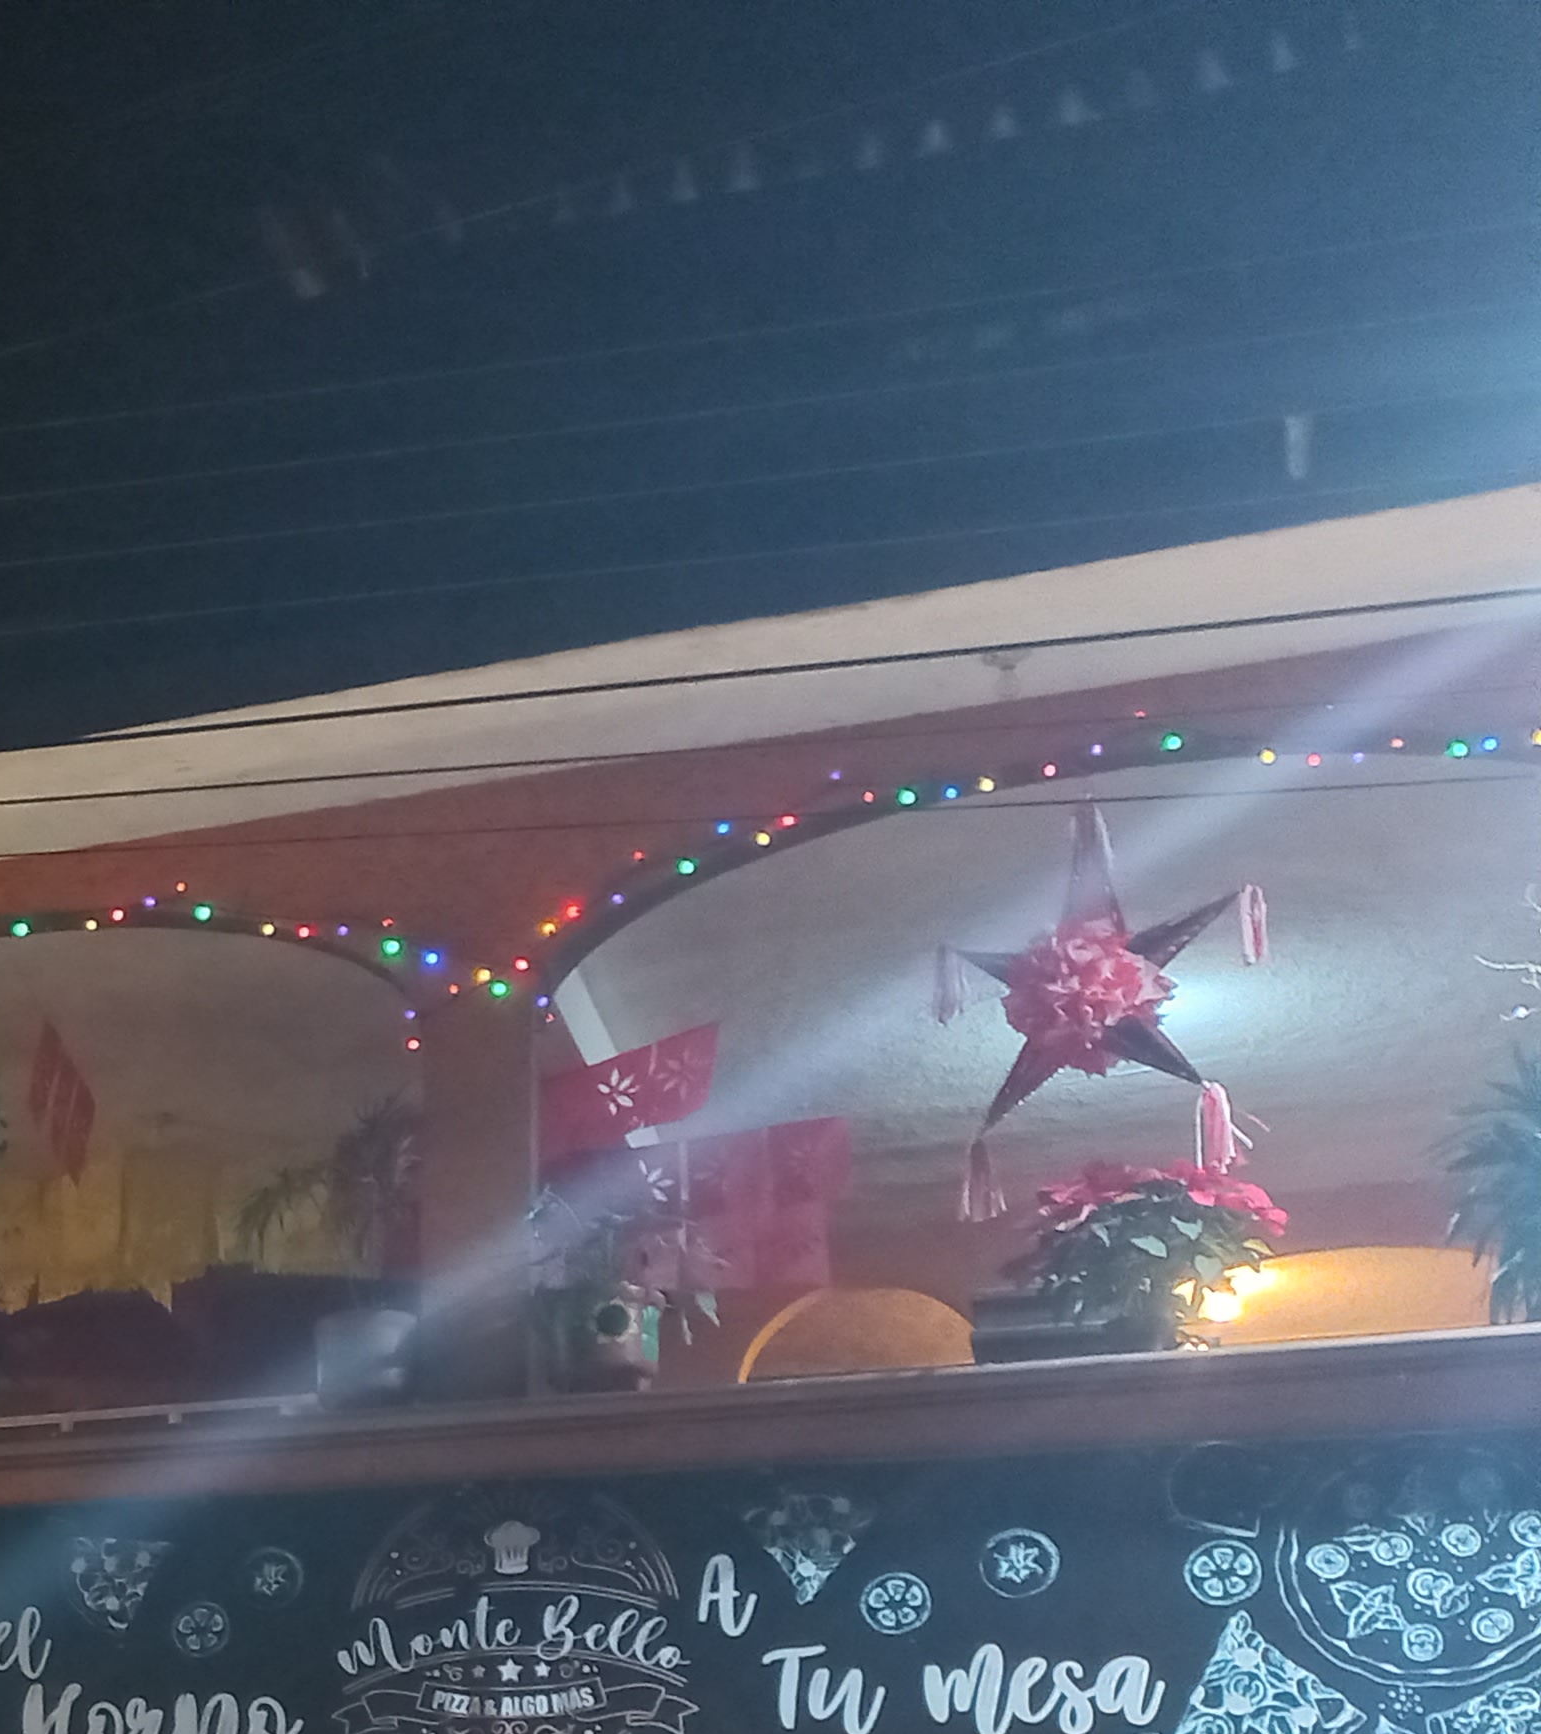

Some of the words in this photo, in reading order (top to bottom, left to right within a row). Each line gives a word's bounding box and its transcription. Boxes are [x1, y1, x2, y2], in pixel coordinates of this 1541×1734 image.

[336, 1594, 522, 1674] Monte
[534, 1593, 692, 1671] Bello
[697, 1553, 758, 1638] A
[431, 1689, 481, 1717] PIZZA
[483, 1699, 497, 1717] &
[500, 1693, 548, 1718] ALGO
[550, 1686, 596, 1714] MAS
